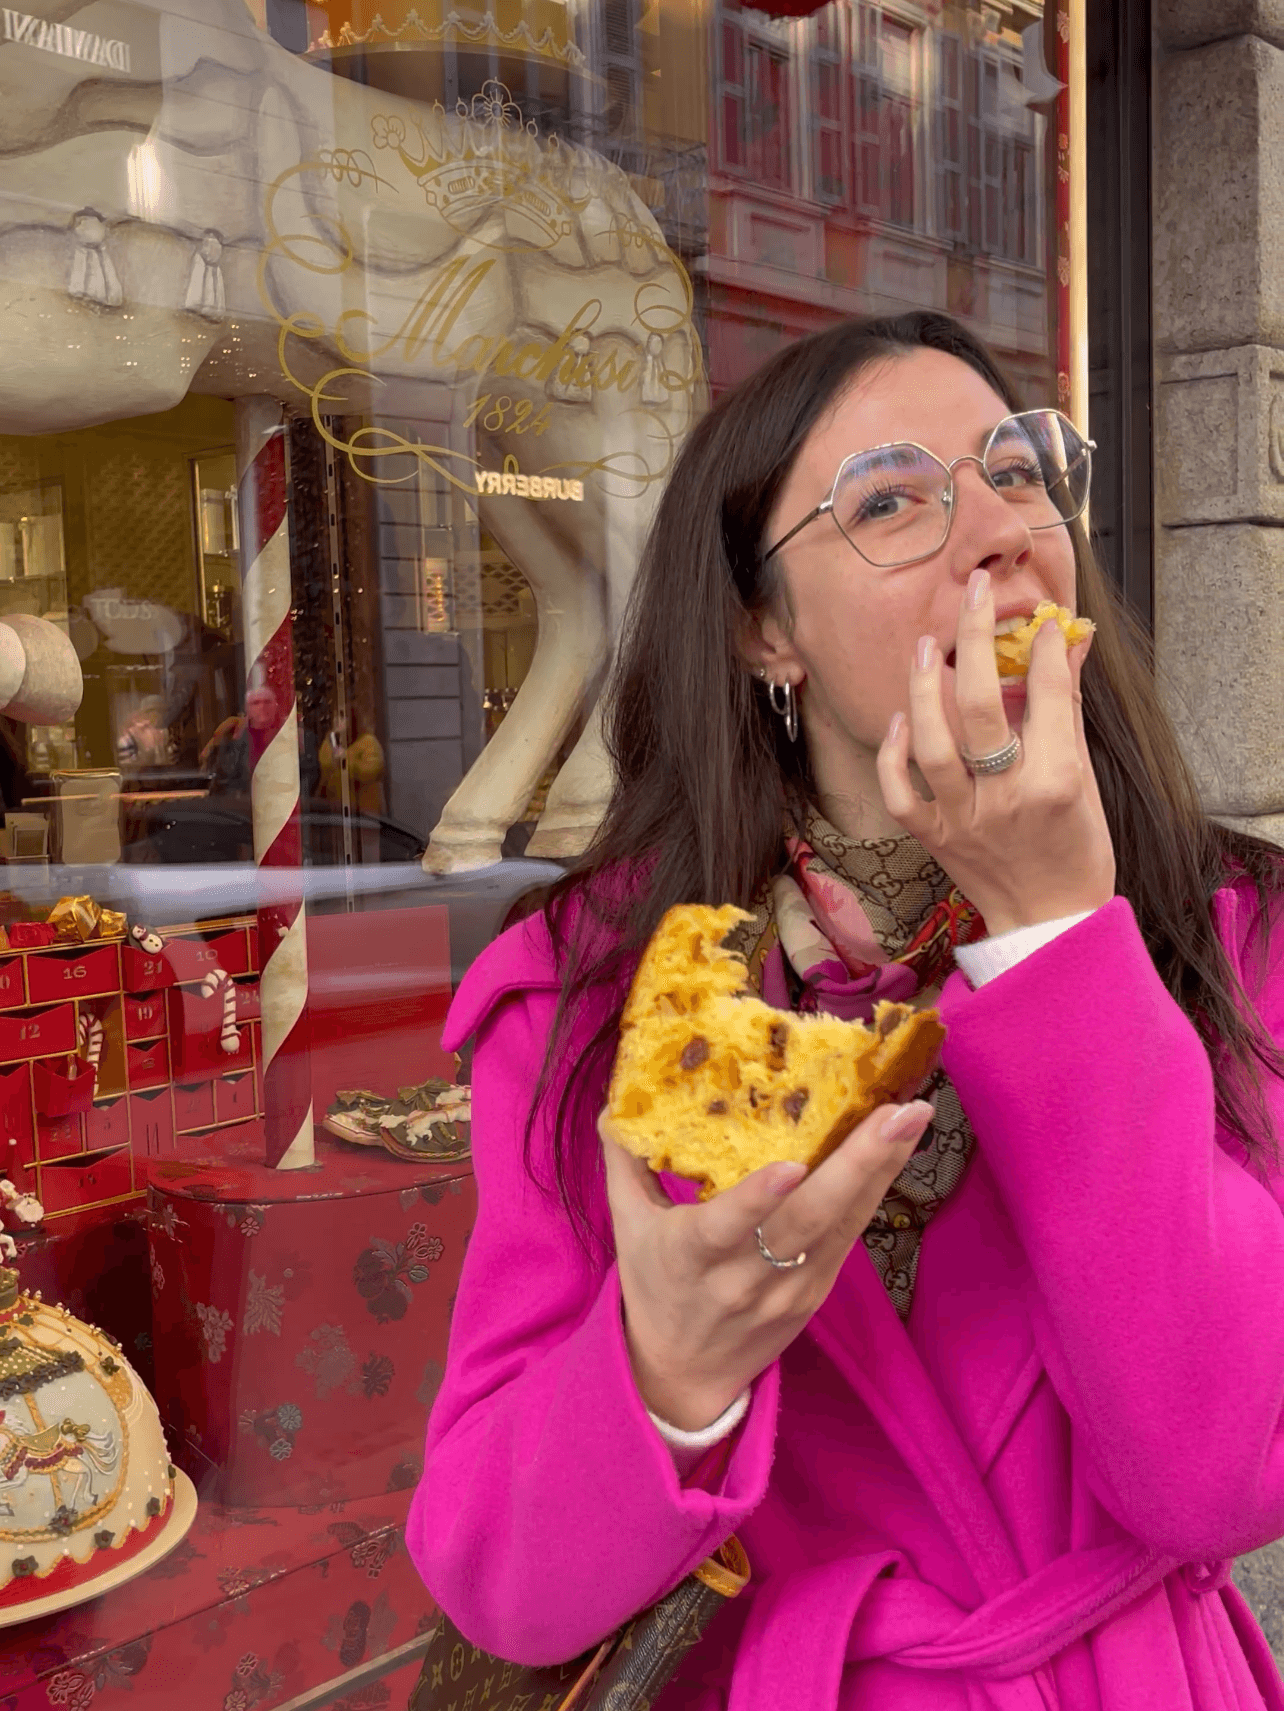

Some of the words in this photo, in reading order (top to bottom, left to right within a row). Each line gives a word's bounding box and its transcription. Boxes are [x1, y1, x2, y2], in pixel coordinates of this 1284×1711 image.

[336, 256, 643, 393] Marchesi
[463, 394, 553, 436] 1824
[63, 965, 87, 980] 16
[19, 1024, 41, 1041] 12
